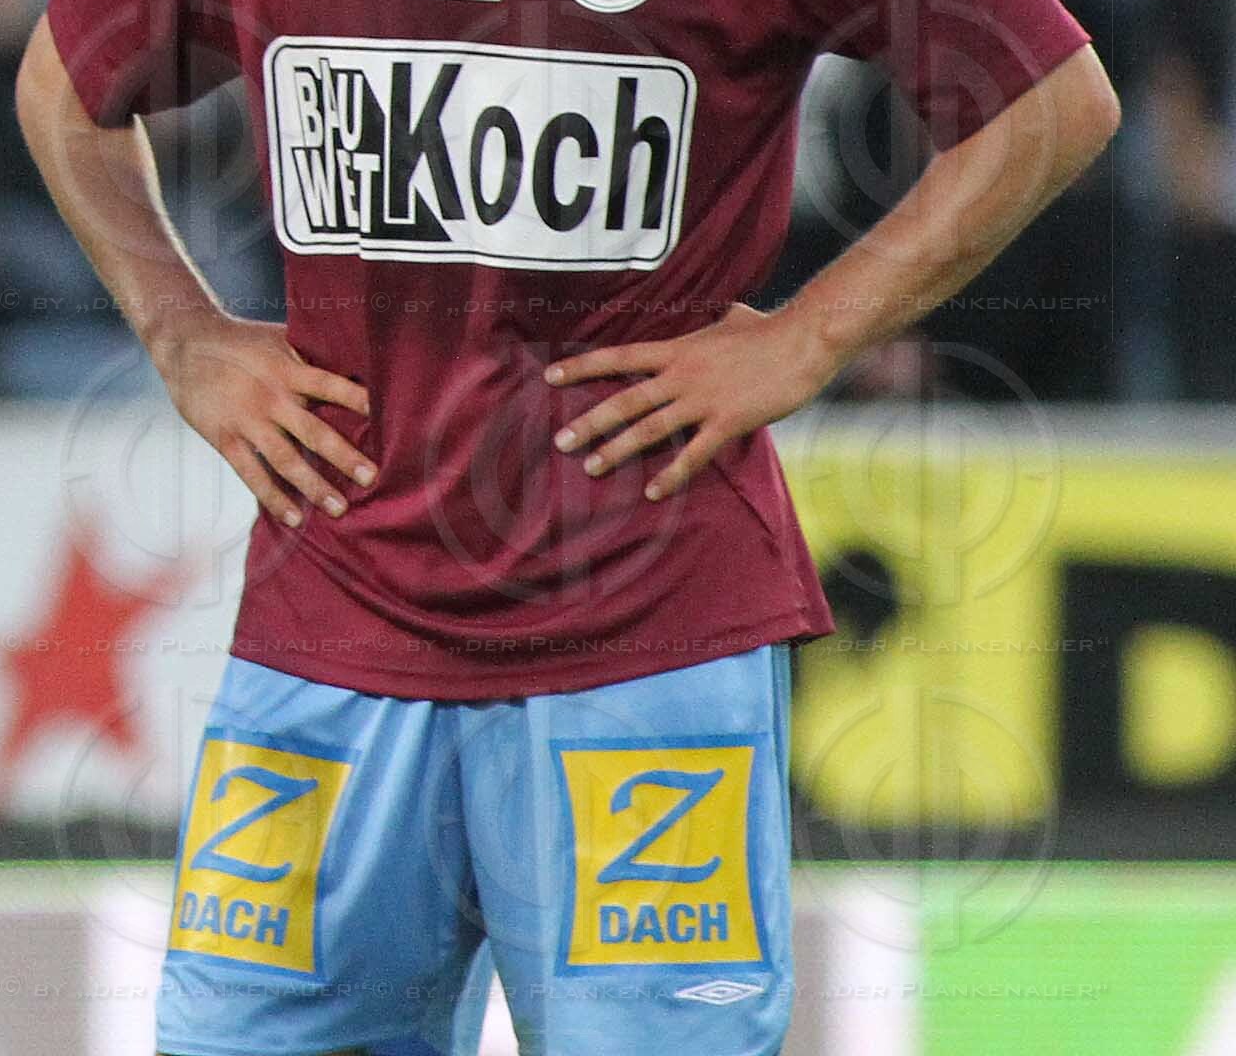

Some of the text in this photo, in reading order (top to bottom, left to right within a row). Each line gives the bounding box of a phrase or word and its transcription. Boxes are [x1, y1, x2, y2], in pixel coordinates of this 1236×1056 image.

[388, 62, 672, 232] Koch
[178, 891, 290, 947] DACH
[599, 902, 729, 945] DACH
